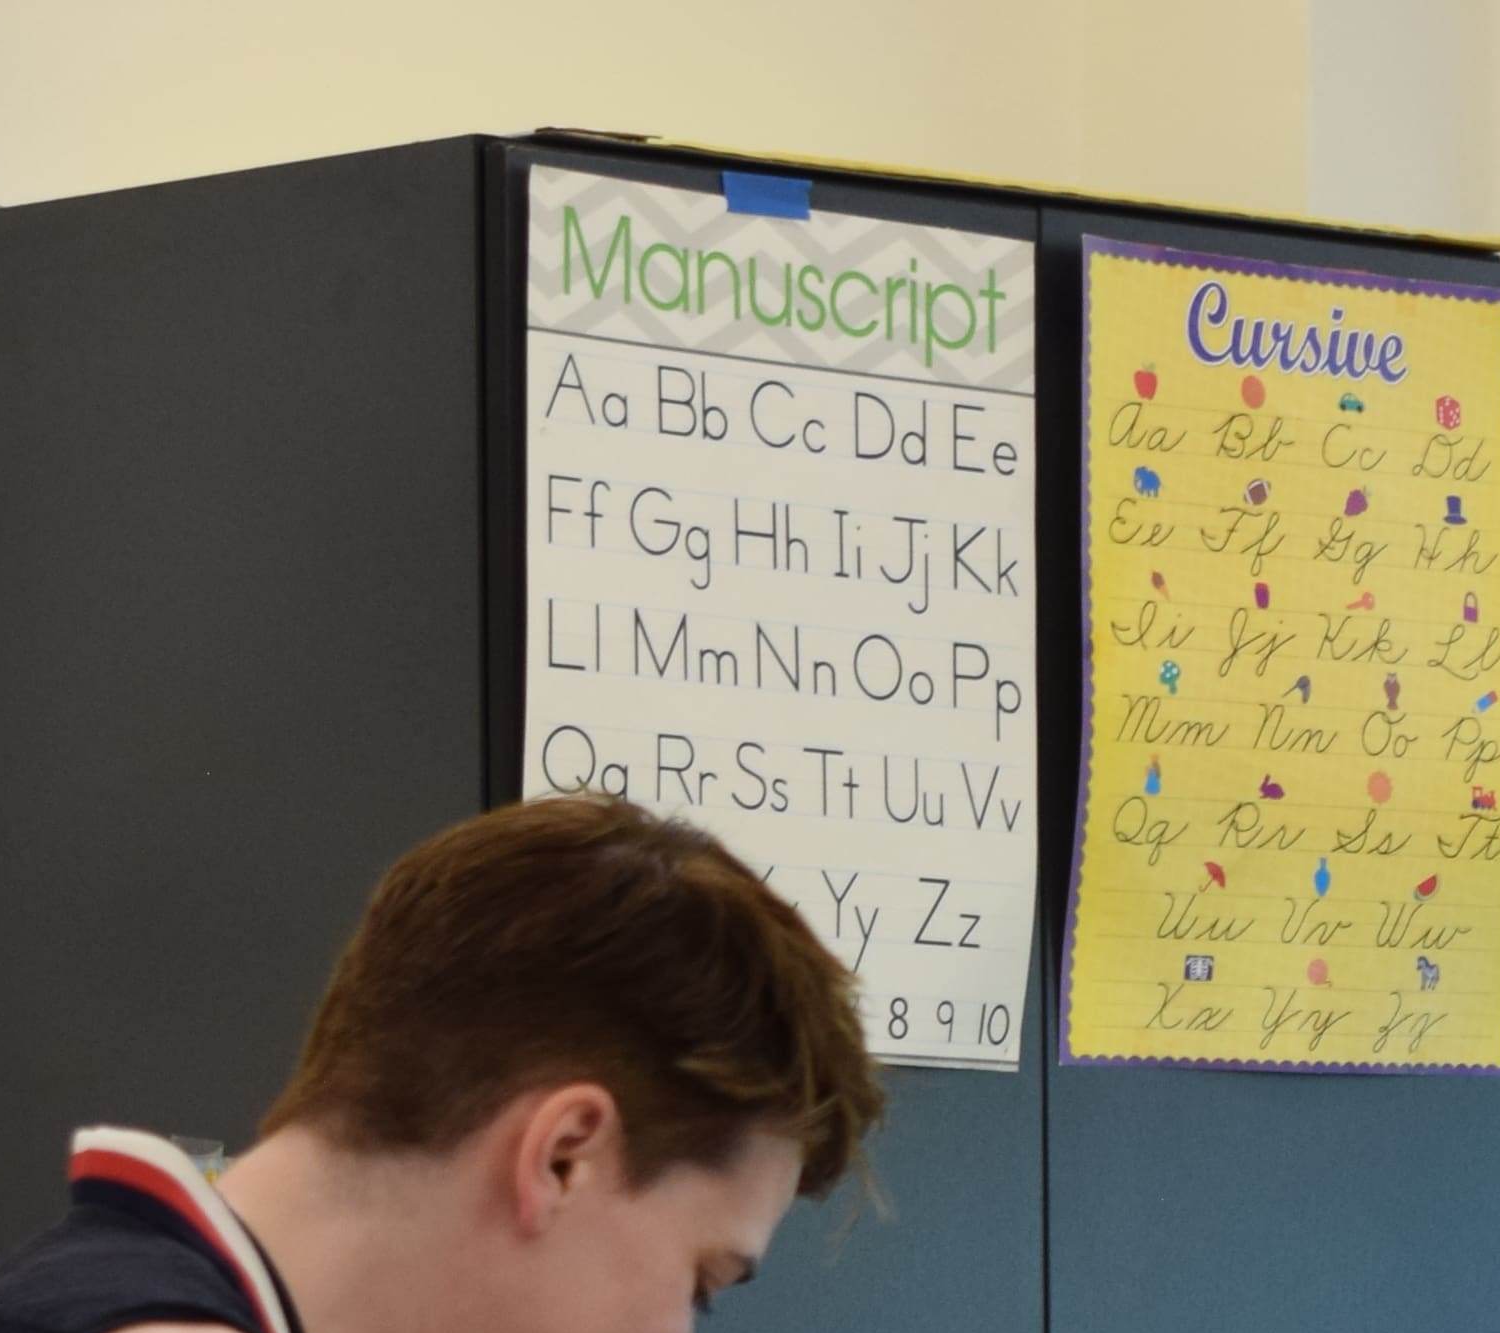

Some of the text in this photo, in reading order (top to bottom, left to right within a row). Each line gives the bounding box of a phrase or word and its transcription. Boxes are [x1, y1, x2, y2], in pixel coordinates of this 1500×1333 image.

[564, 206, 1006, 368] Manuscript
[1187, 282, 1407, 382] Cursive
[545, 354, 1018, 476] Aa Bb Cc Dd Ee
[548, 475, 1018, 614] Ff Gg Hh Ii Jj Kk
[635, 607, 738, 687] Mm
[755, 623, 837, 697] Nn
[853, 634, 934, 706] Oo
[952, 641, 1021, 742] Pp
[656, 734, 718, 805] Rr
[731, 742, 789, 812] Ss
[803, 748, 860, 819] Tt
[884, 755, 944, 827] Uu
[961, 763, 1022, 832] Vv
[914, 877, 981, 949] Zz
[887, 997, 1010, 1046] 8 9 10
